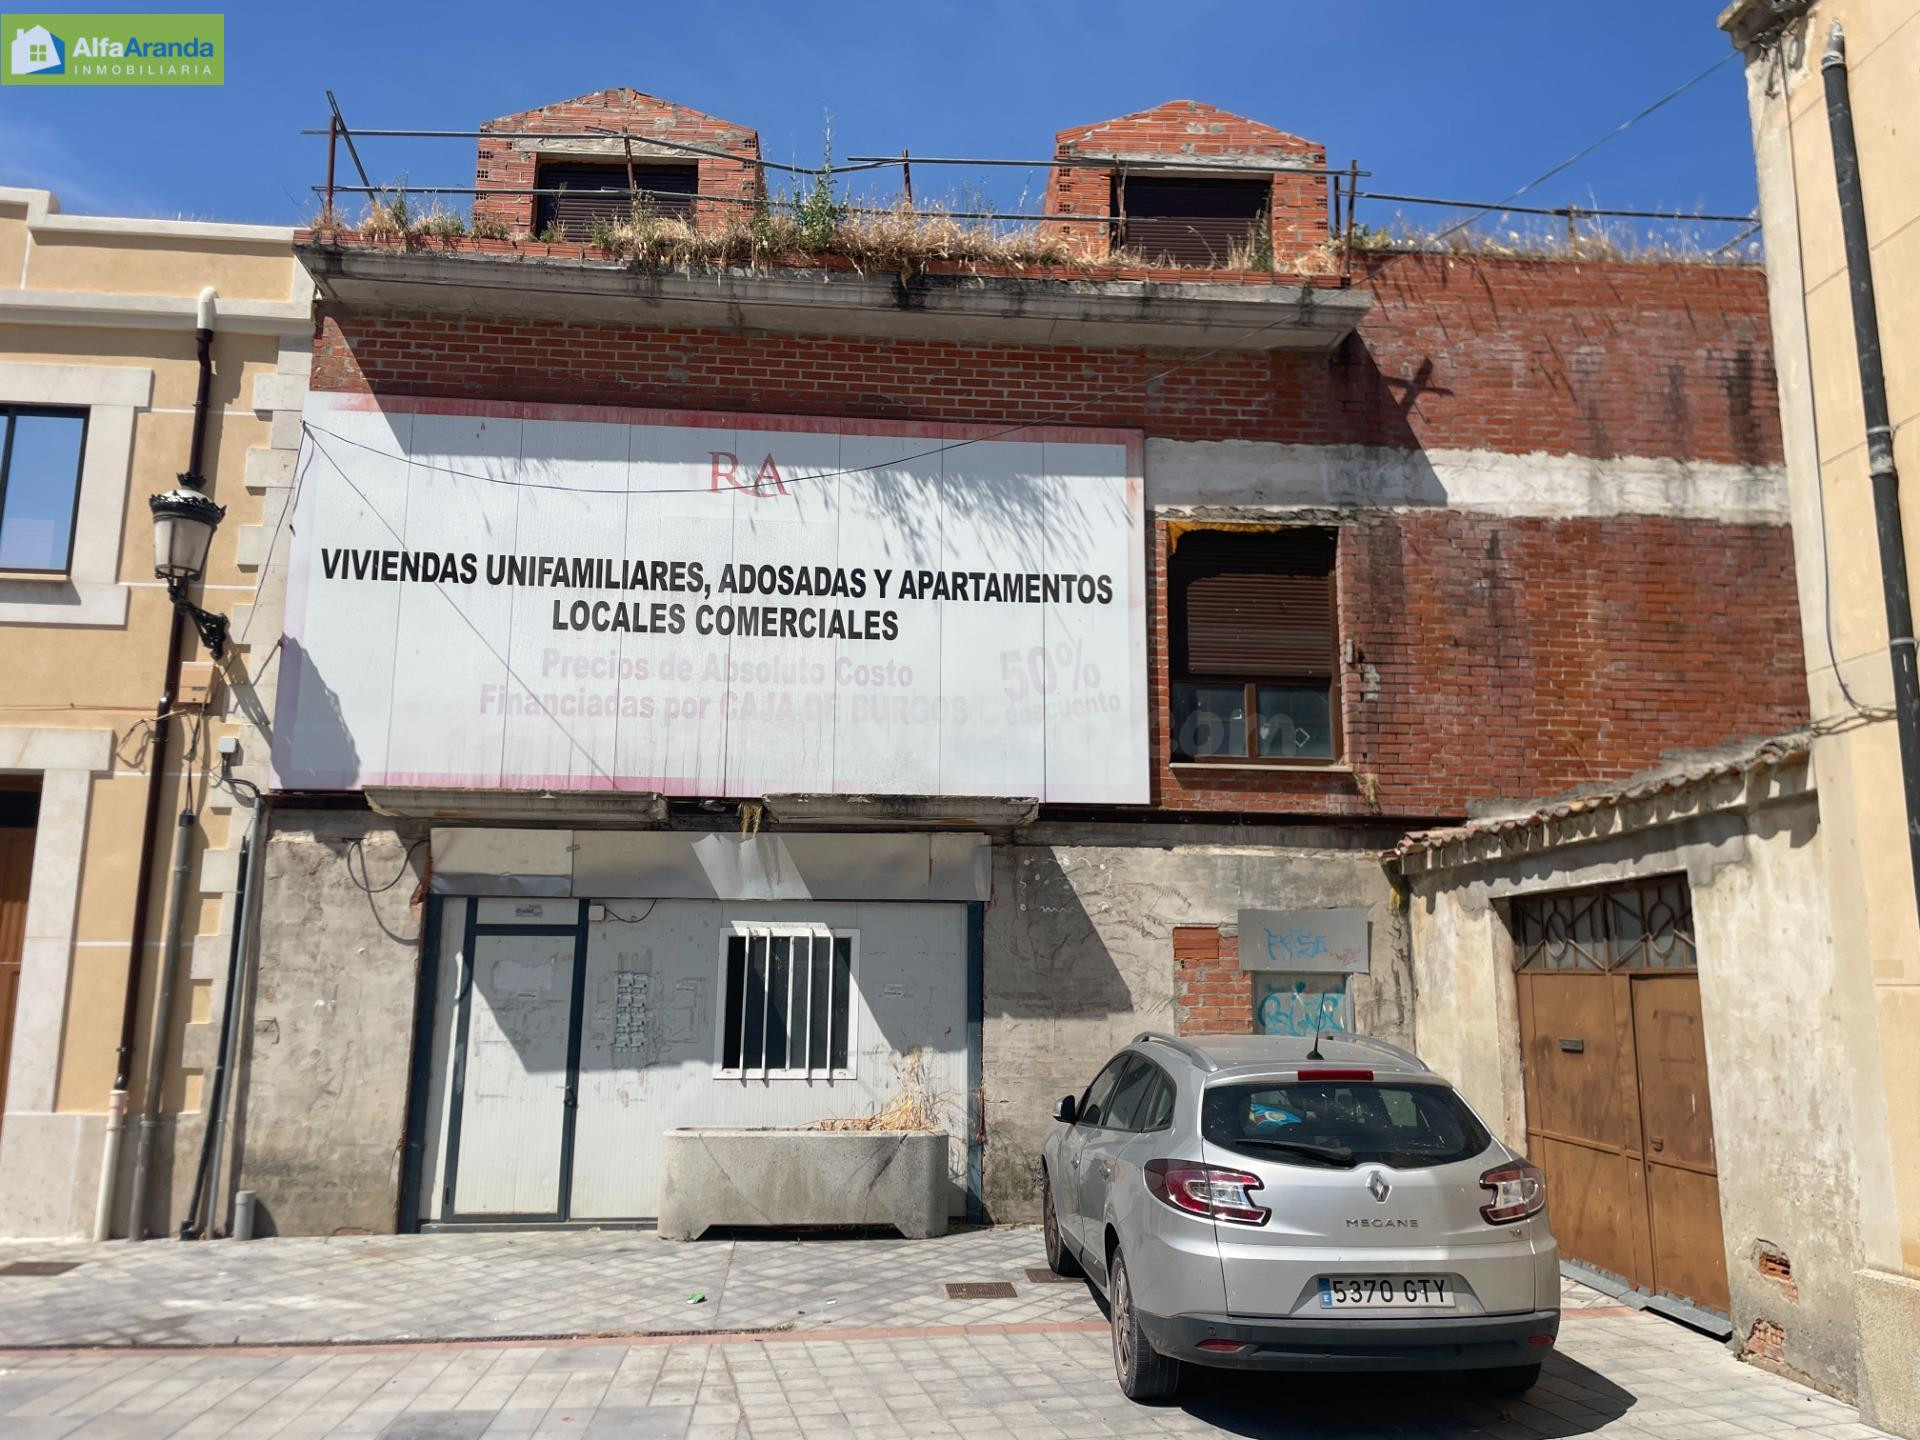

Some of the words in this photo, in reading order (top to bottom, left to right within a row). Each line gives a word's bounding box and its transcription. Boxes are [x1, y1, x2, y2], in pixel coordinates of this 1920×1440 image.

[707, 450, 793, 498] RA
[320, 547, 478, 584] VIVIENDAS
[485, 554, 711, 600] UNIFAMILIARES,
[717, 563, 867, 599] ADOSADAS
[873, 569, 893, 599] Y
[898, 569, 1113, 605] APARTAMENTOS
[552, 599, 686, 635] LOCALES
[693, 604, 899, 640] COMERCIALES
[541, 647, 650, 681] Precios
[658, 652, 693, 681] de
[701, 652, 825, 685] Absoluto
[836, 655, 914, 688] Costo
[999, 637, 1102, 702] 50%
[479, 683, 656, 719] Financiadas
[664, 690, 712, 726] por
[718, 689, 796, 723] CAJA
[851, 693, 969, 726] BURGOS
[1345, 1218, 1420, 1229] MEGANE
[1332, 1280, 1394, 1304] 5370
[1403, 1279, 1446, 1304] GTY
